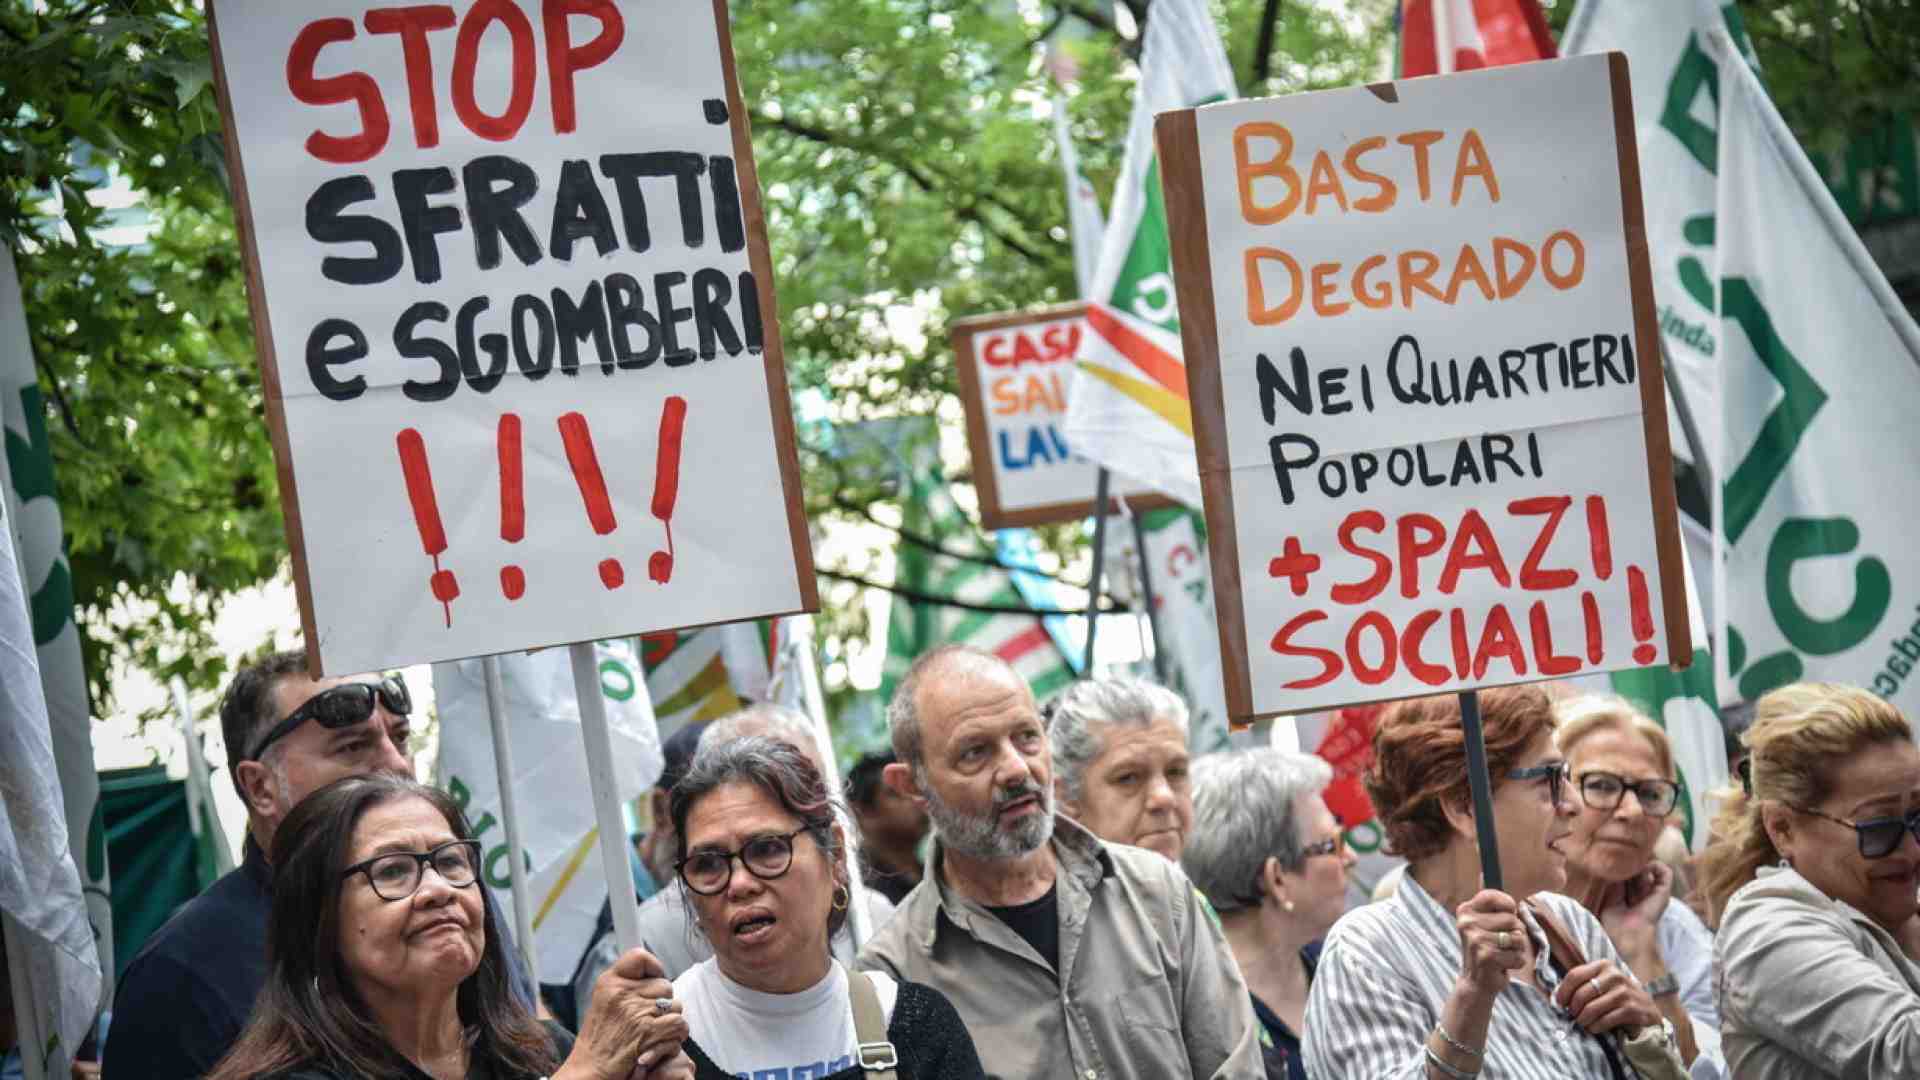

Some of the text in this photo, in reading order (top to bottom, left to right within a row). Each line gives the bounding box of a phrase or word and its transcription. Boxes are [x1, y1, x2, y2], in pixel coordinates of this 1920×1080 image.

[287, 0, 625, 163] STOP
[1232, 121, 1500, 226] BASTA
[1244, 231, 1586, 326] DEGRADO
[392, 267, 764, 403] SGOMBERI
[1255, 333, 1637, 426] NEI QUARTIERI
[1268, 432, 1544, 507] POPOLARI
